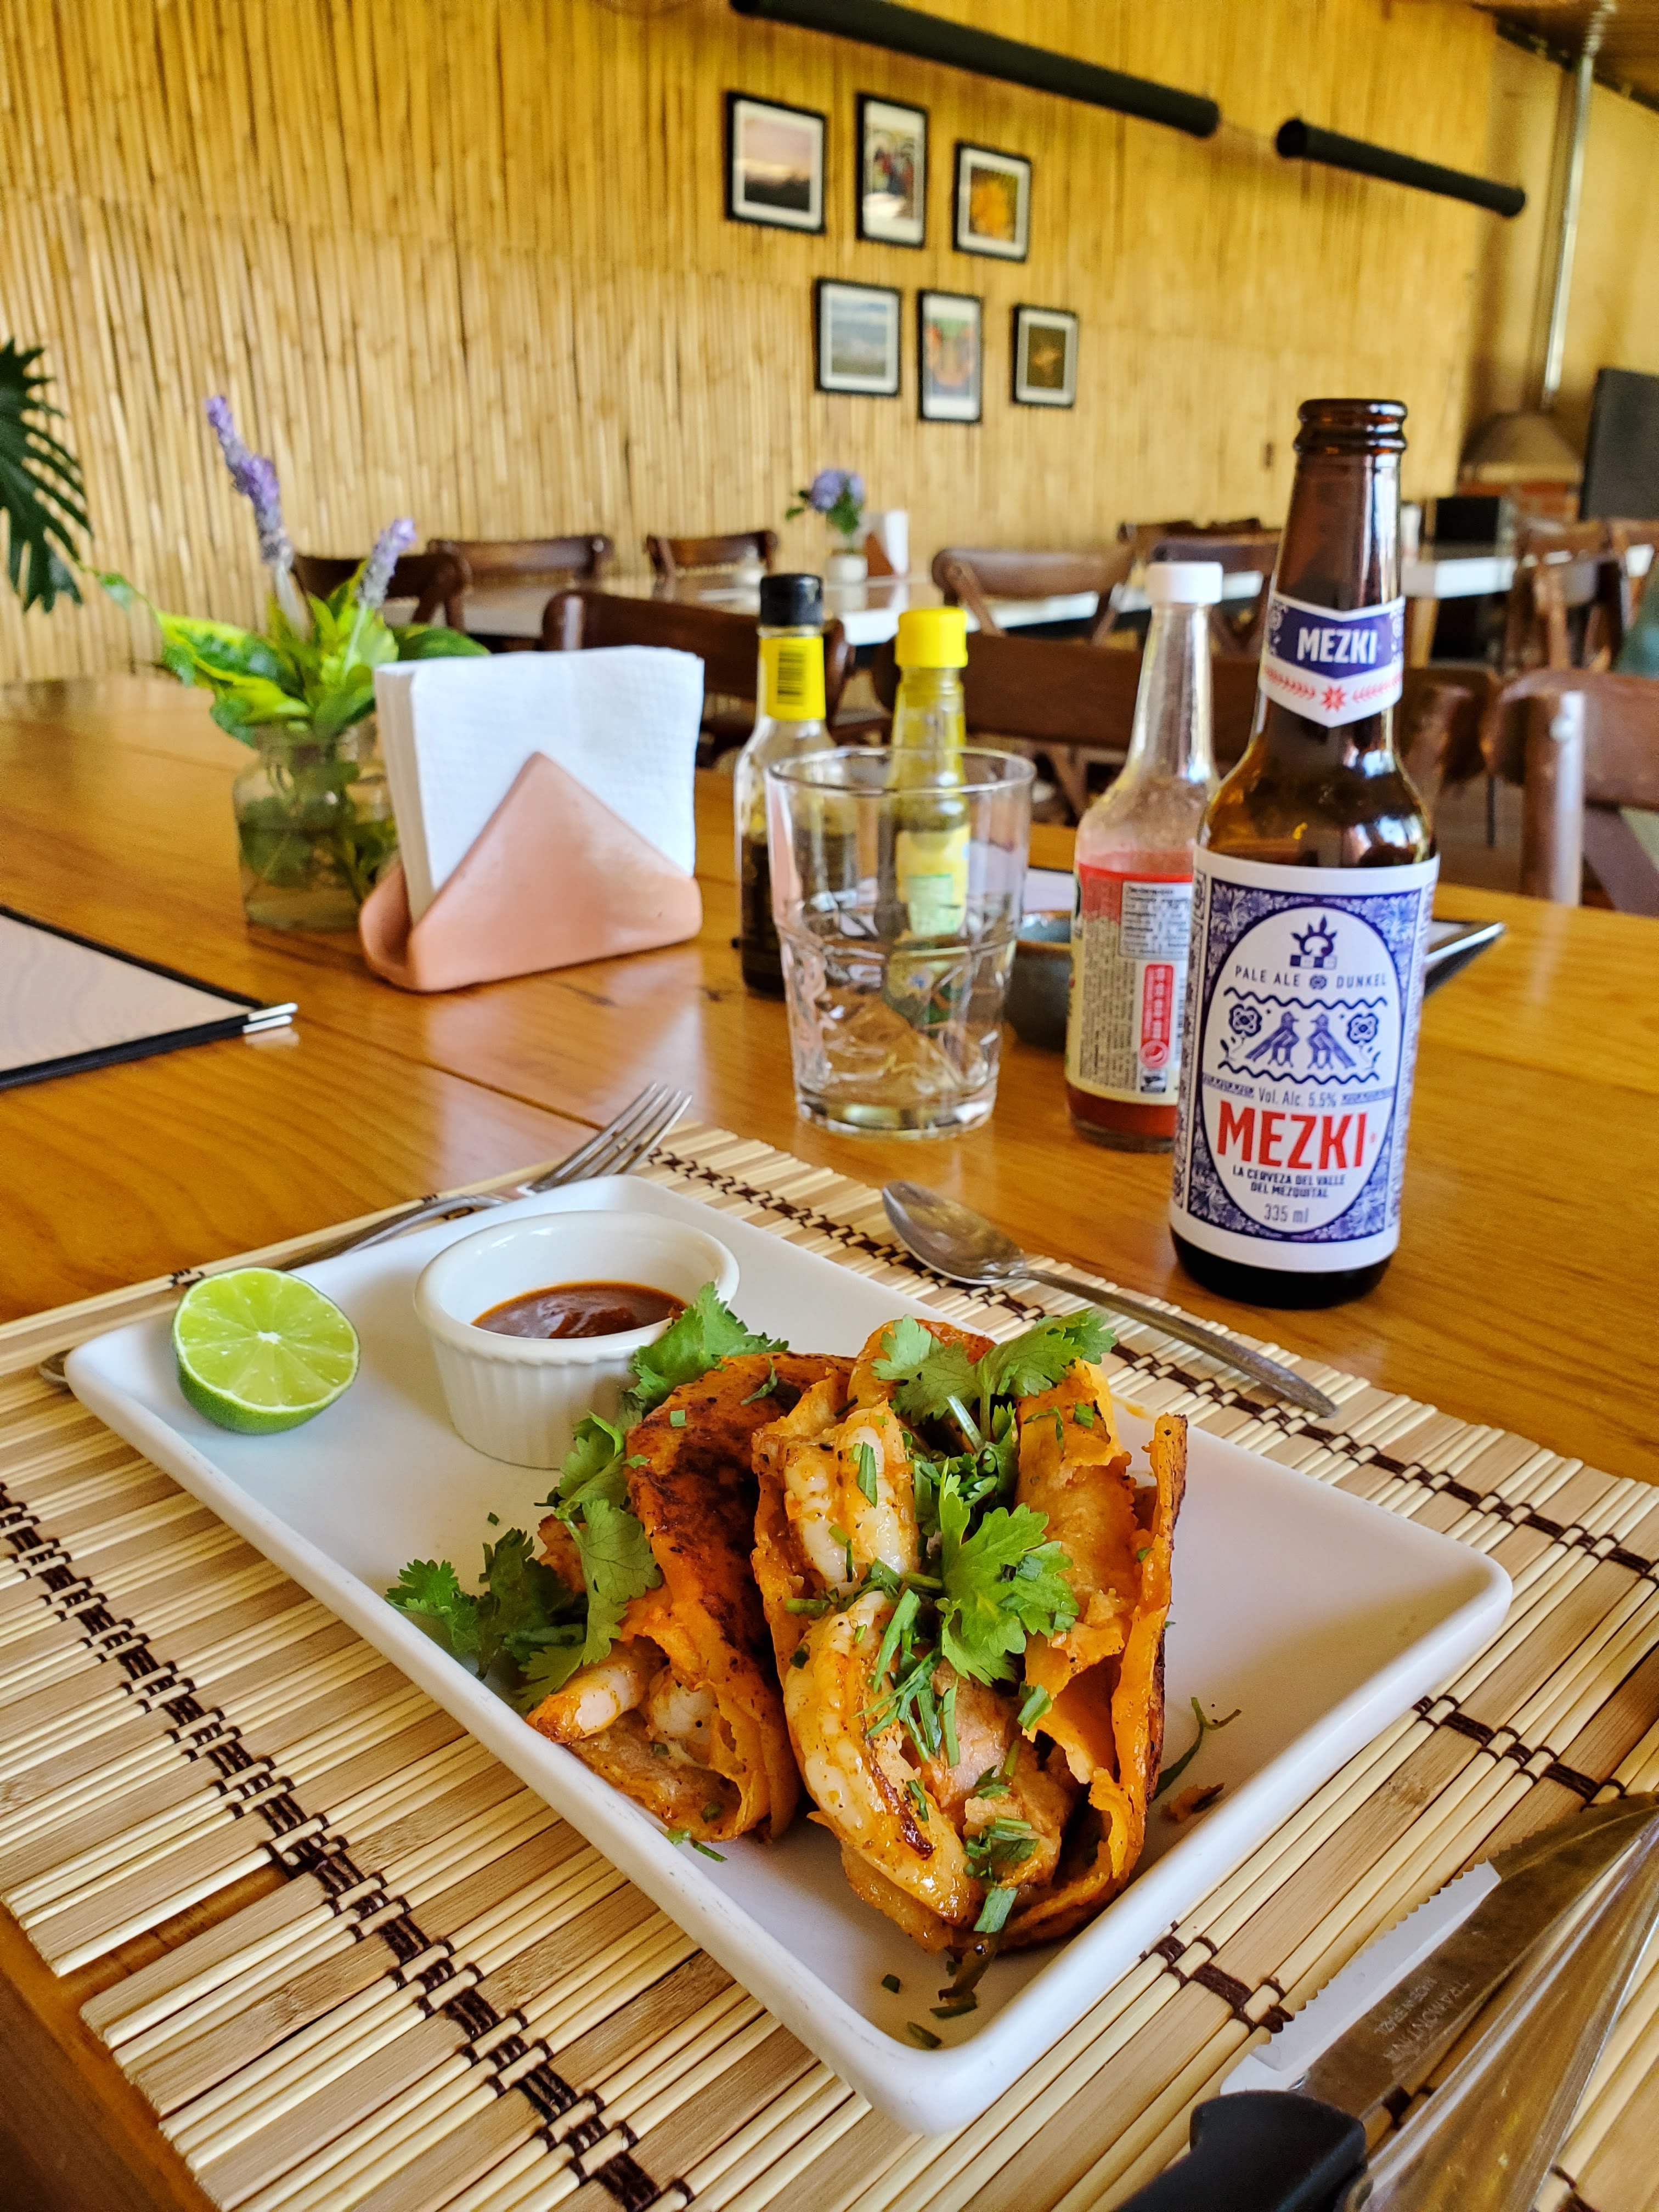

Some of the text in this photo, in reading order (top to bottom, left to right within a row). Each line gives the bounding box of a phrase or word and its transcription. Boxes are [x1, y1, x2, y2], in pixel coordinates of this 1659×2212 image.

[1297, 628, 1378, 664] MEZKI
[1235, 966, 1387, 989] PALE ALE DUNKEL
[1259, 1087, 1337, 1108] Vol. Alc. 5.5%
[1217, 1101, 1367, 1169] MEZKI
[1233, 1165, 1345, 1186] LA CERVEZA DEL VALLE
[1251, 1182, 1328, 1198] DEL MEZQUITAL
[1263, 1204, 1310, 1223] 335 ml
